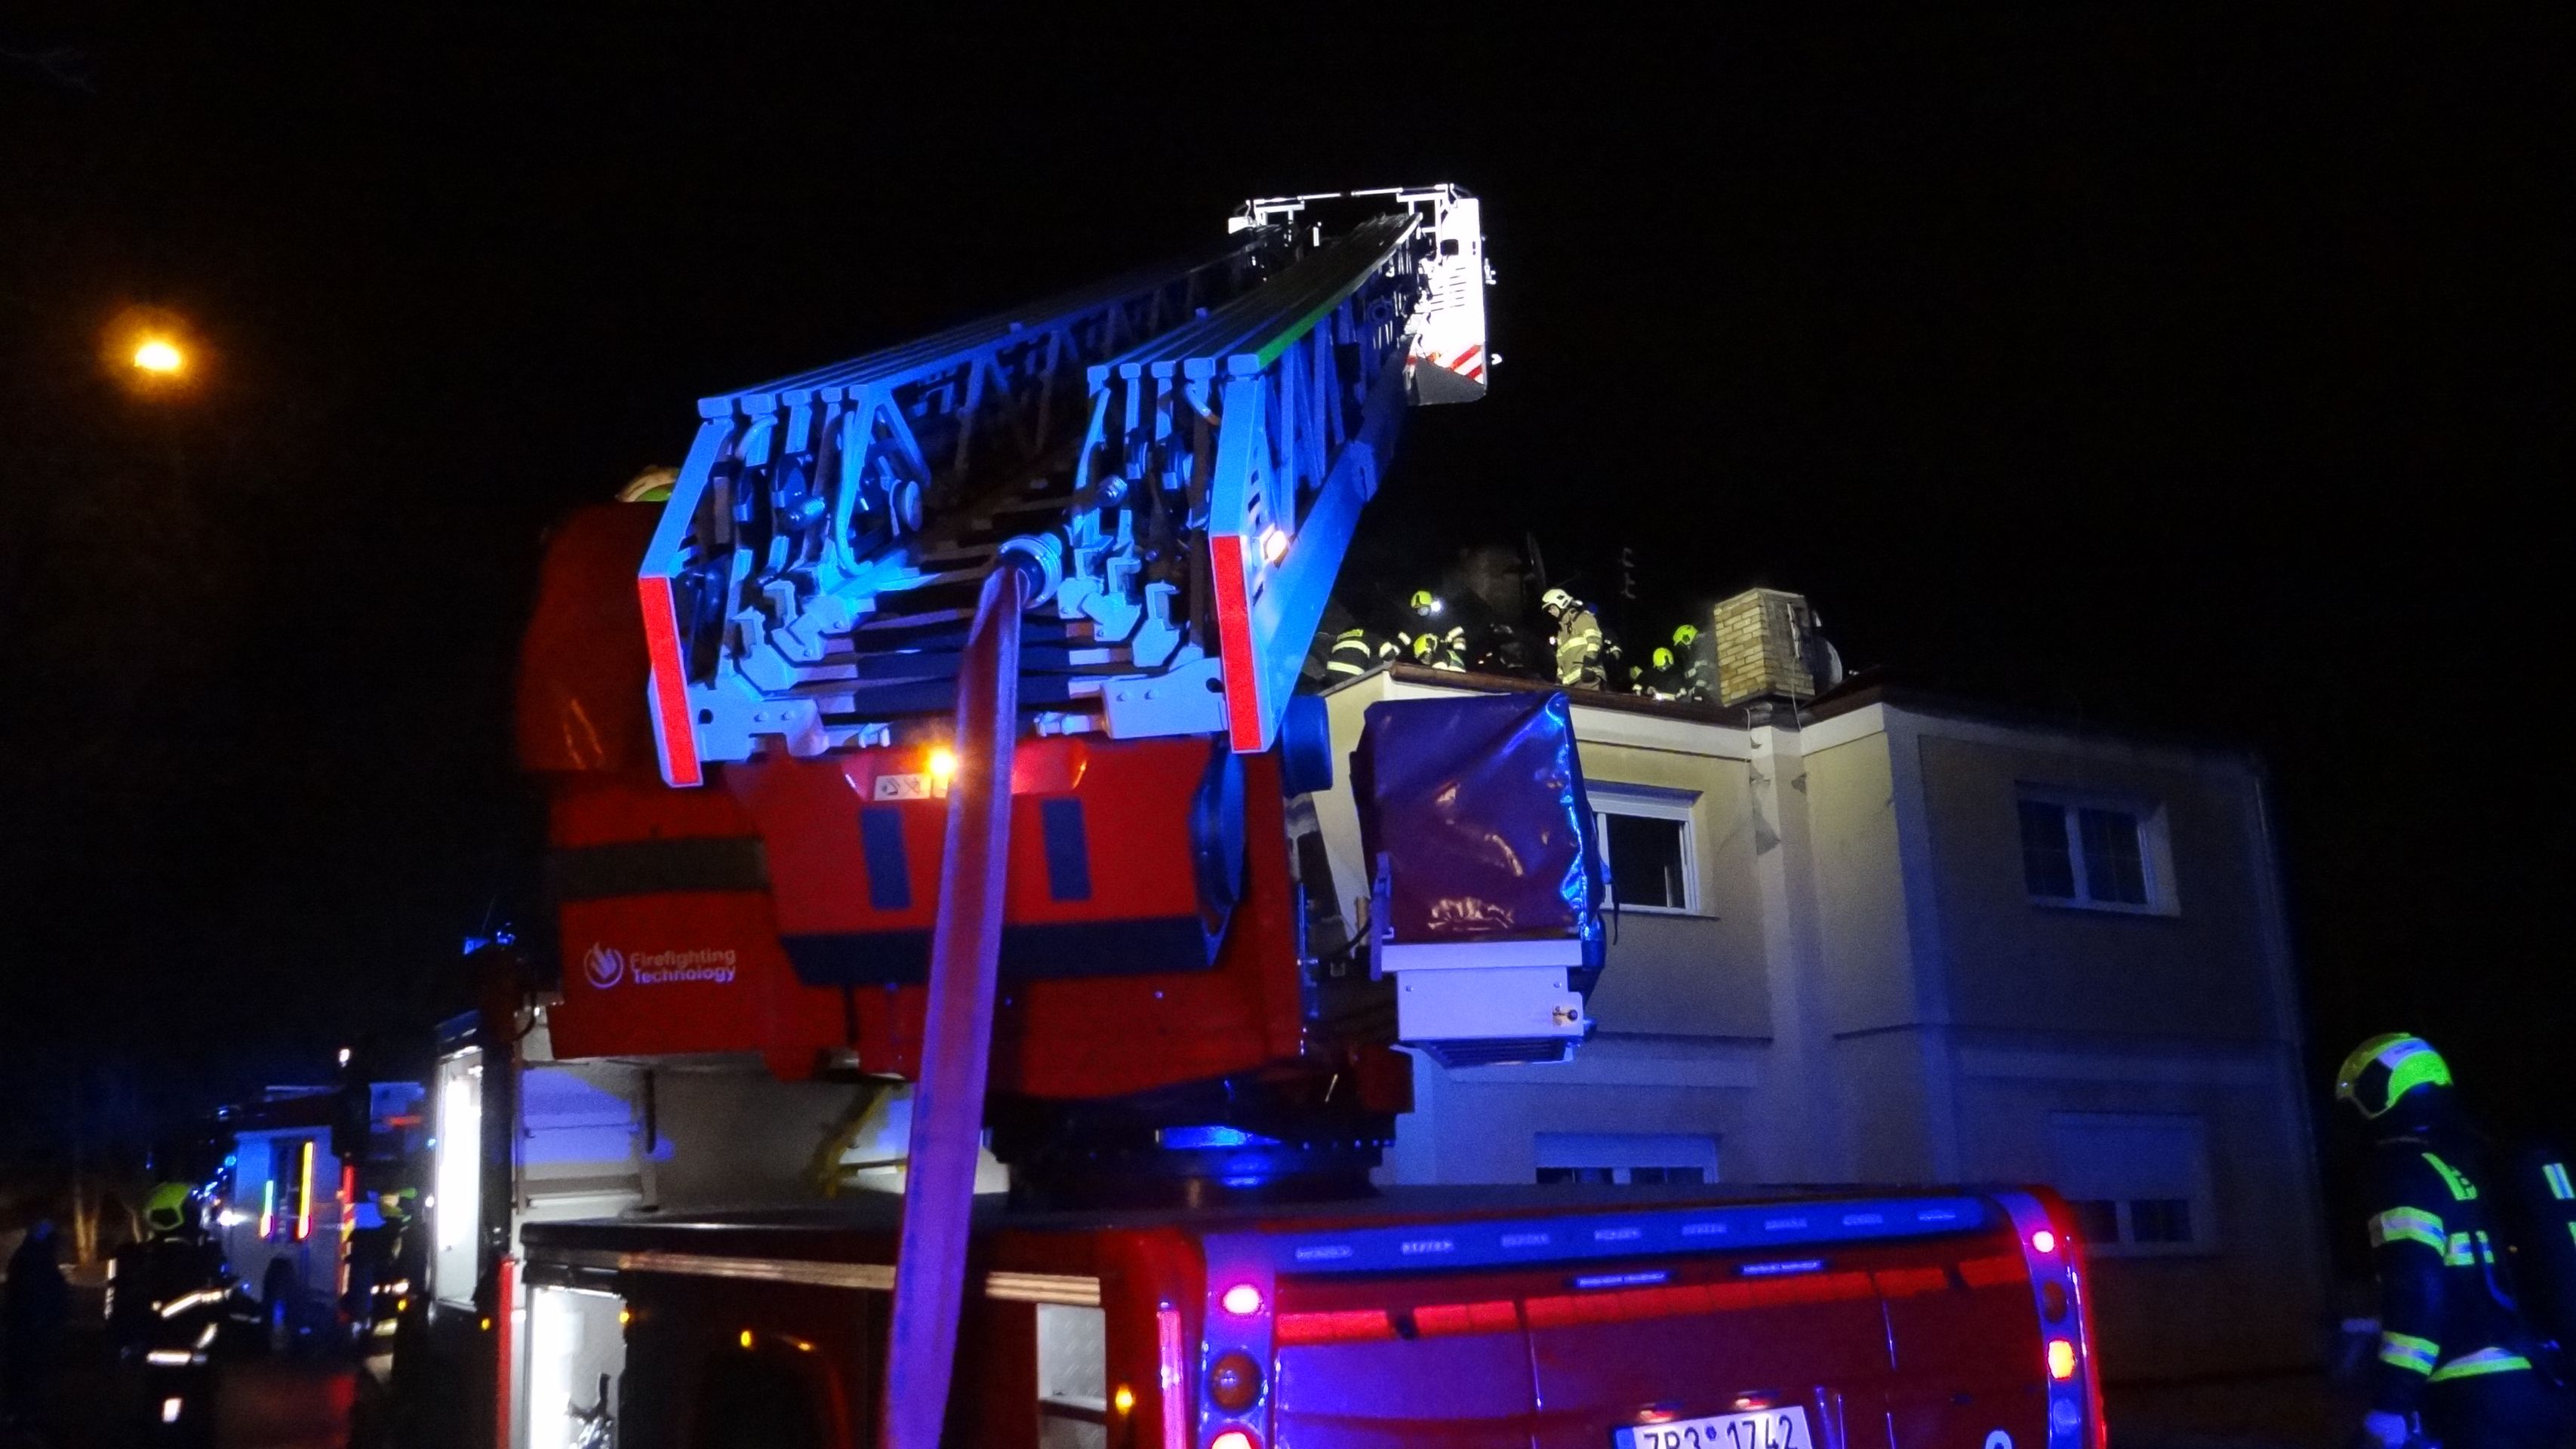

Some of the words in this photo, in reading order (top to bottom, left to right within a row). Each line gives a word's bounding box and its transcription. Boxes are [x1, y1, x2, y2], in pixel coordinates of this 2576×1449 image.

[629, 949, 737, 968] Firefighting
[630, 965, 737, 983] Technology
[1726, 1414, 1798, 1449] 1742
